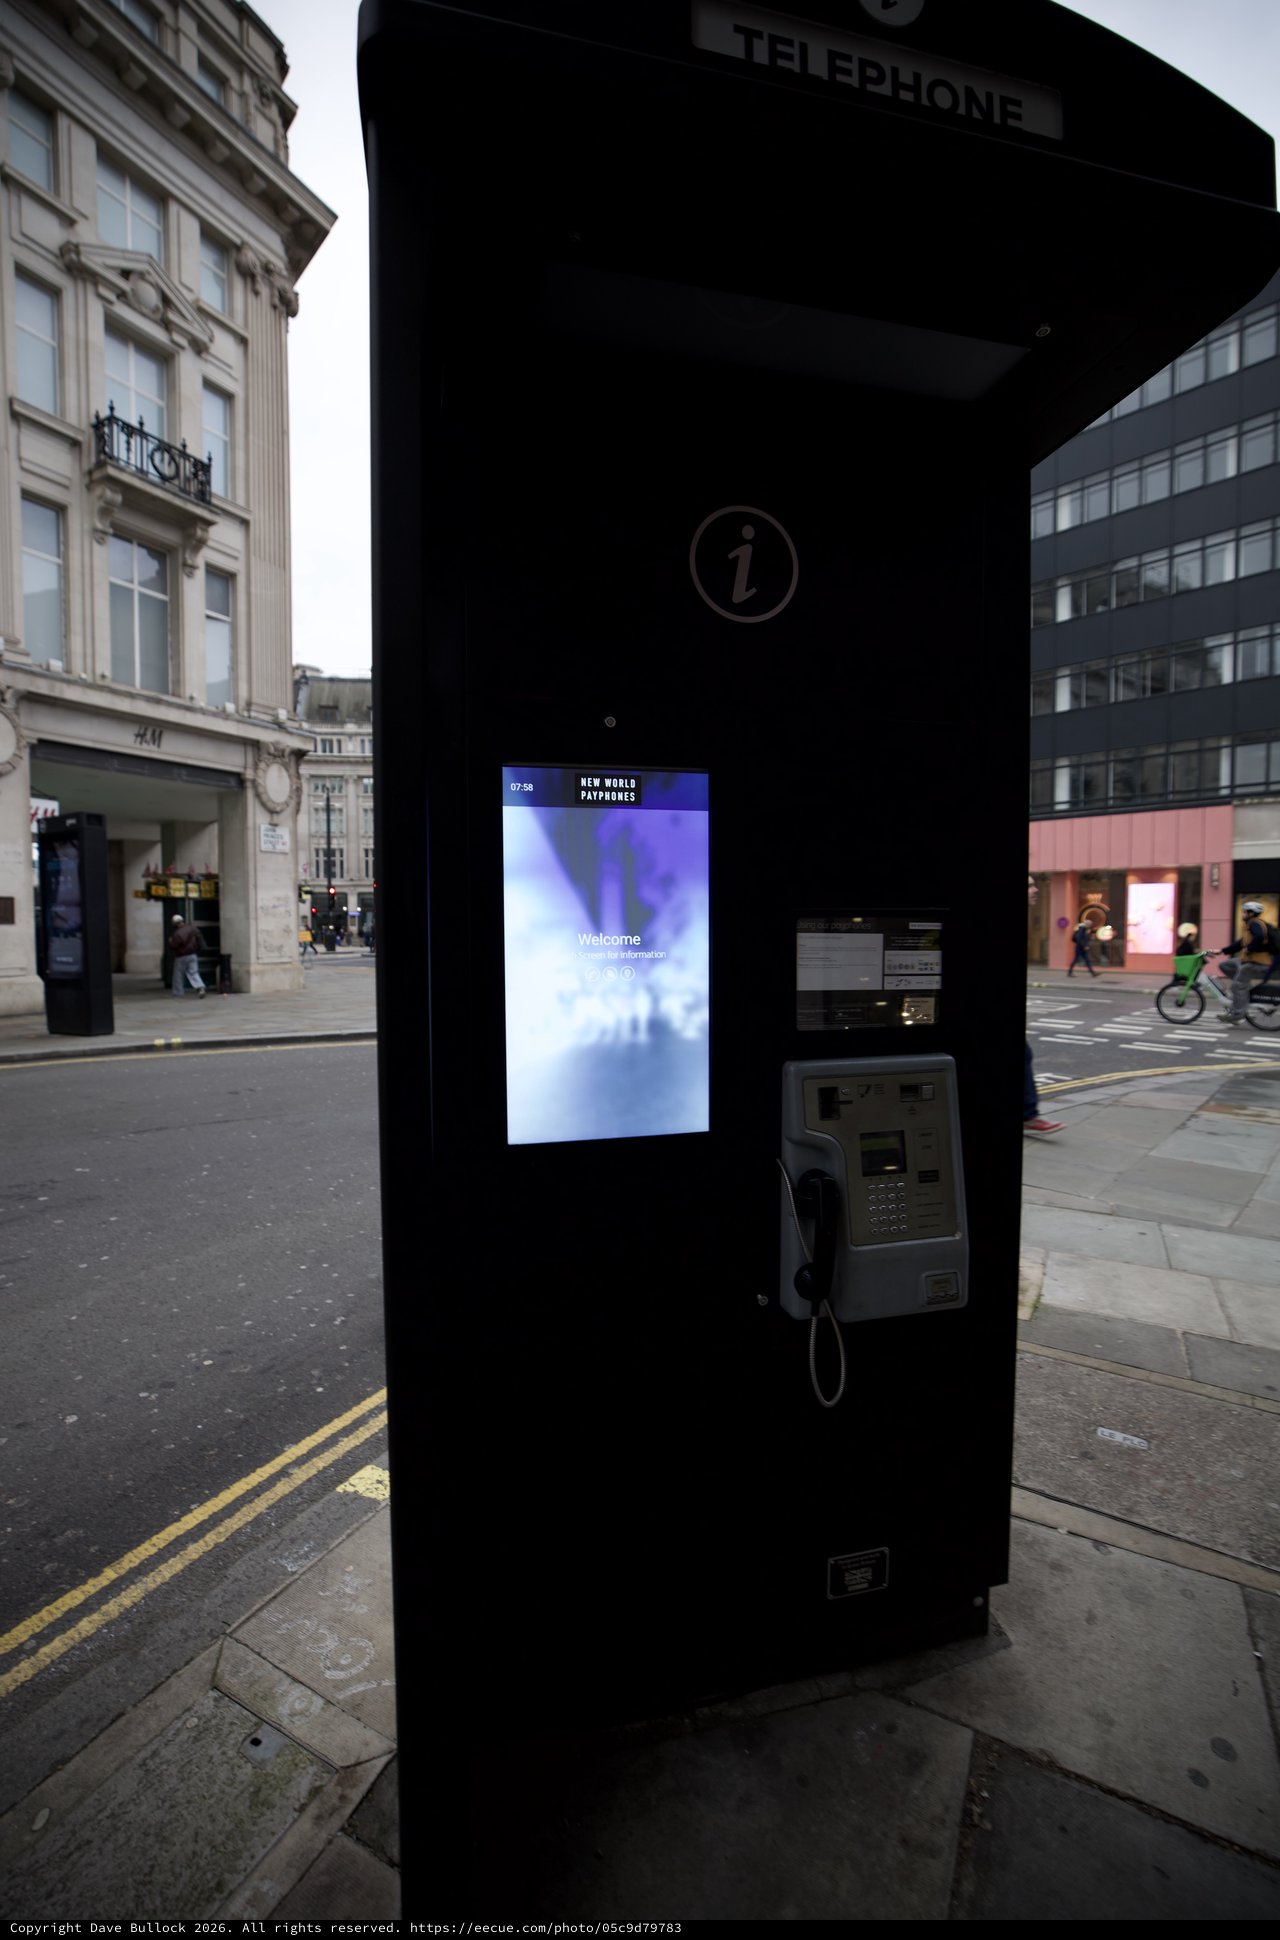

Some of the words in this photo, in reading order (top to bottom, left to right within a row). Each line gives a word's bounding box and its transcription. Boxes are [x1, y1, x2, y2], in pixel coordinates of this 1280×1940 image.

[734, 24, 1022, 128] TELEPHONE
[133, 725, 163, 748] H&M
[510, 783, 533, 792] 07:58
[581, 777, 600, 788] NEW
[605, 778, 636, 789] WORLD
[581, 791, 636, 801] PAYPHONES
[578, 932, 641, 946] Welcome
[607, 951, 618, 960] for
[620, 950, 667, 960] information
